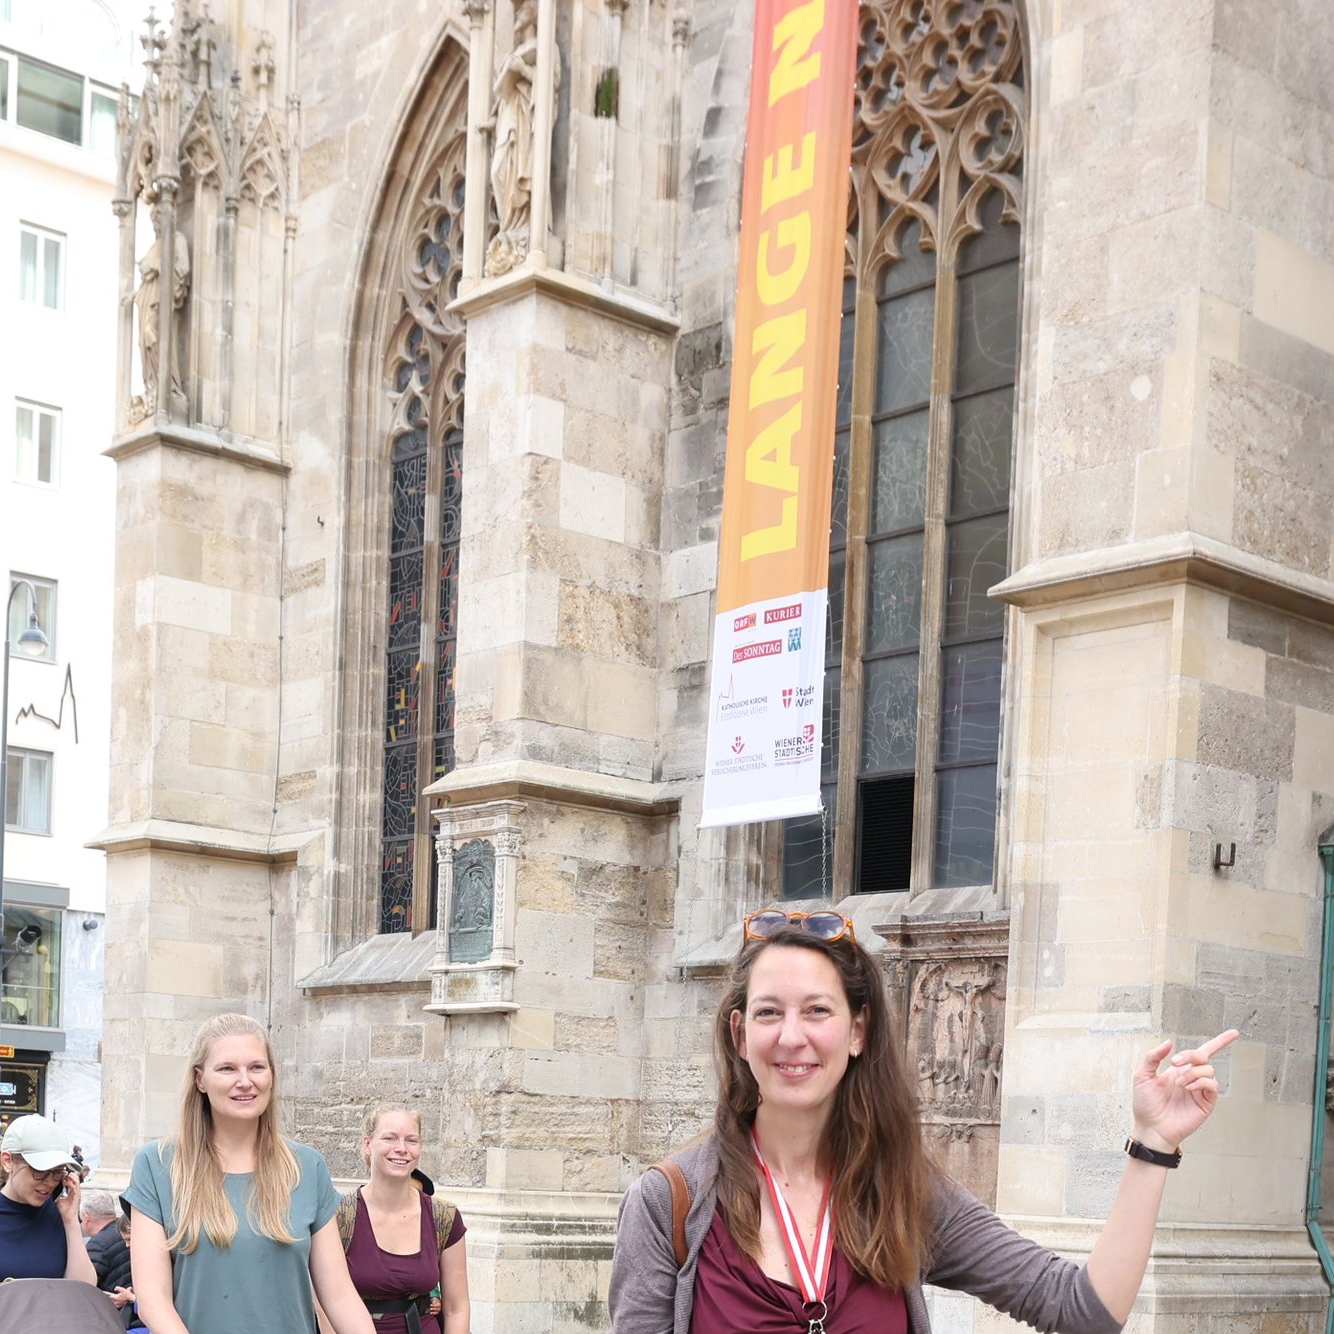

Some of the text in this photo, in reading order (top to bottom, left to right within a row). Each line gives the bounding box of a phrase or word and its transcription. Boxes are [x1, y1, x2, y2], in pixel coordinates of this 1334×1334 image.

[740, 130, 818, 563] LANGE
[765, 606, 801, 623] KURIER
[733, 650, 744, 662] Der
[743, 641, 781, 659] SONNTAG
[795, 685, 815, 697] Stadt
[774, 736, 803, 748] WIENER
